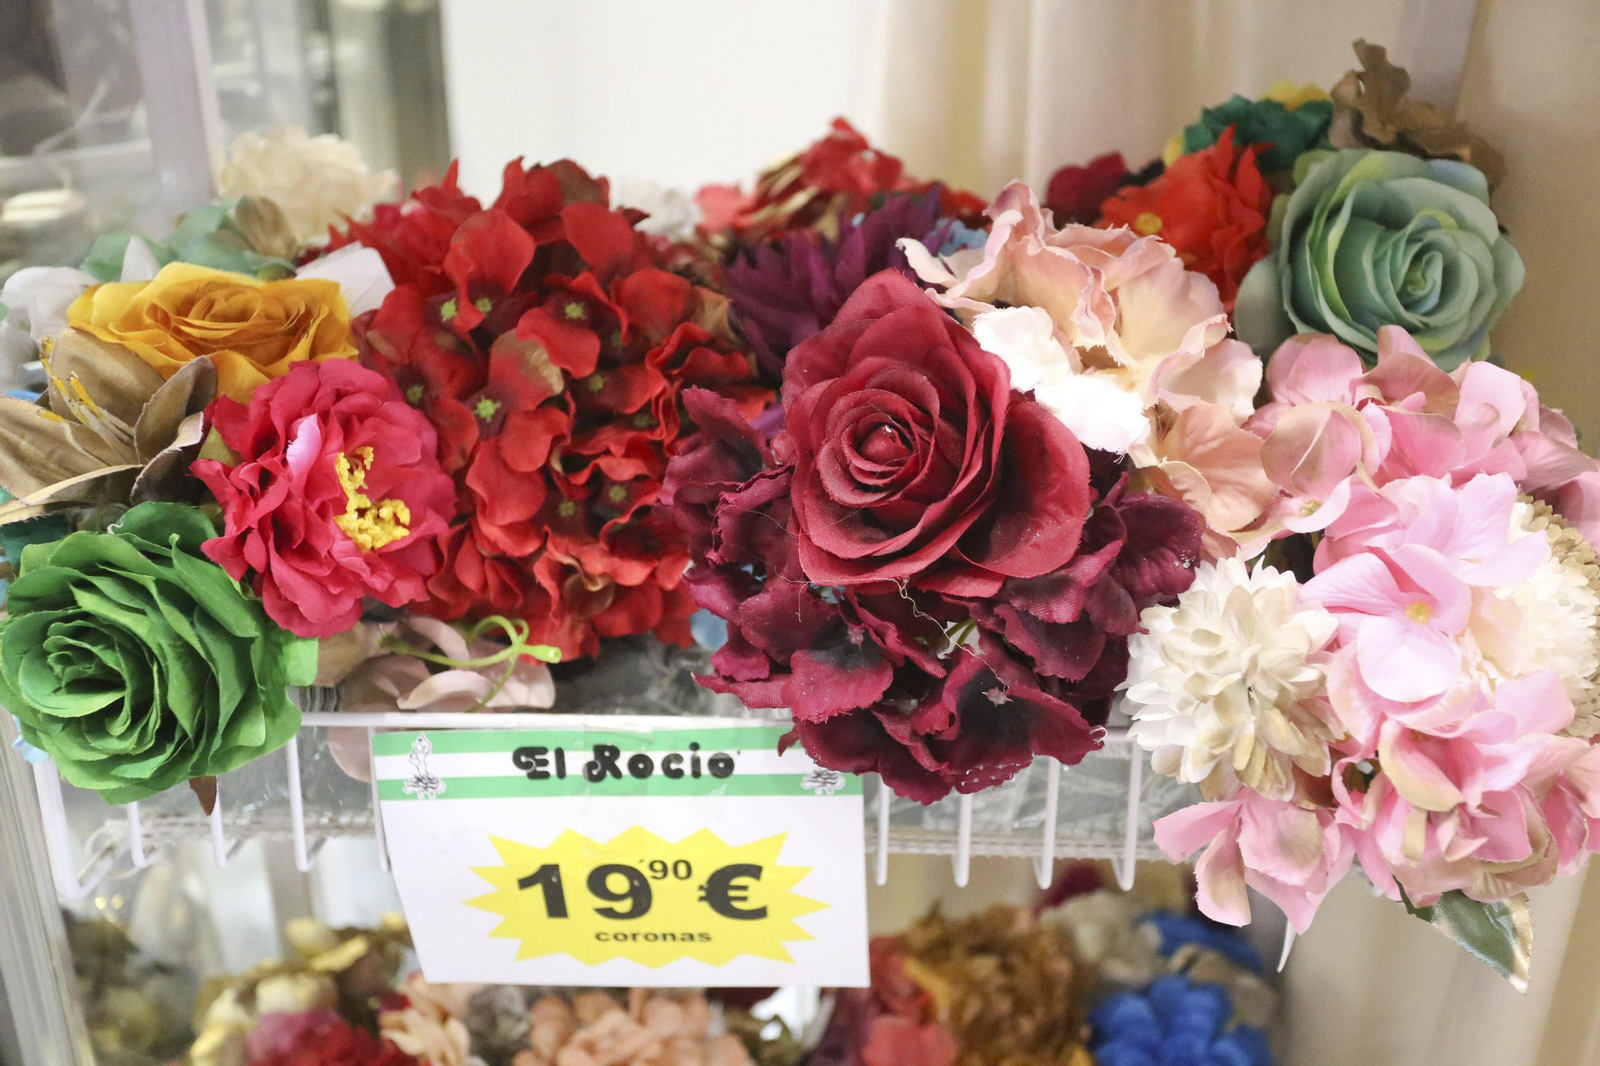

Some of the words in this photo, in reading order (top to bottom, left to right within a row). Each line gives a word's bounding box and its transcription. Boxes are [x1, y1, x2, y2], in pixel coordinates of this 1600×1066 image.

[512, 746, 567, 780] El
[583, 741, 735, 783] Rocio
[594, 930, 713, 943] coronas
